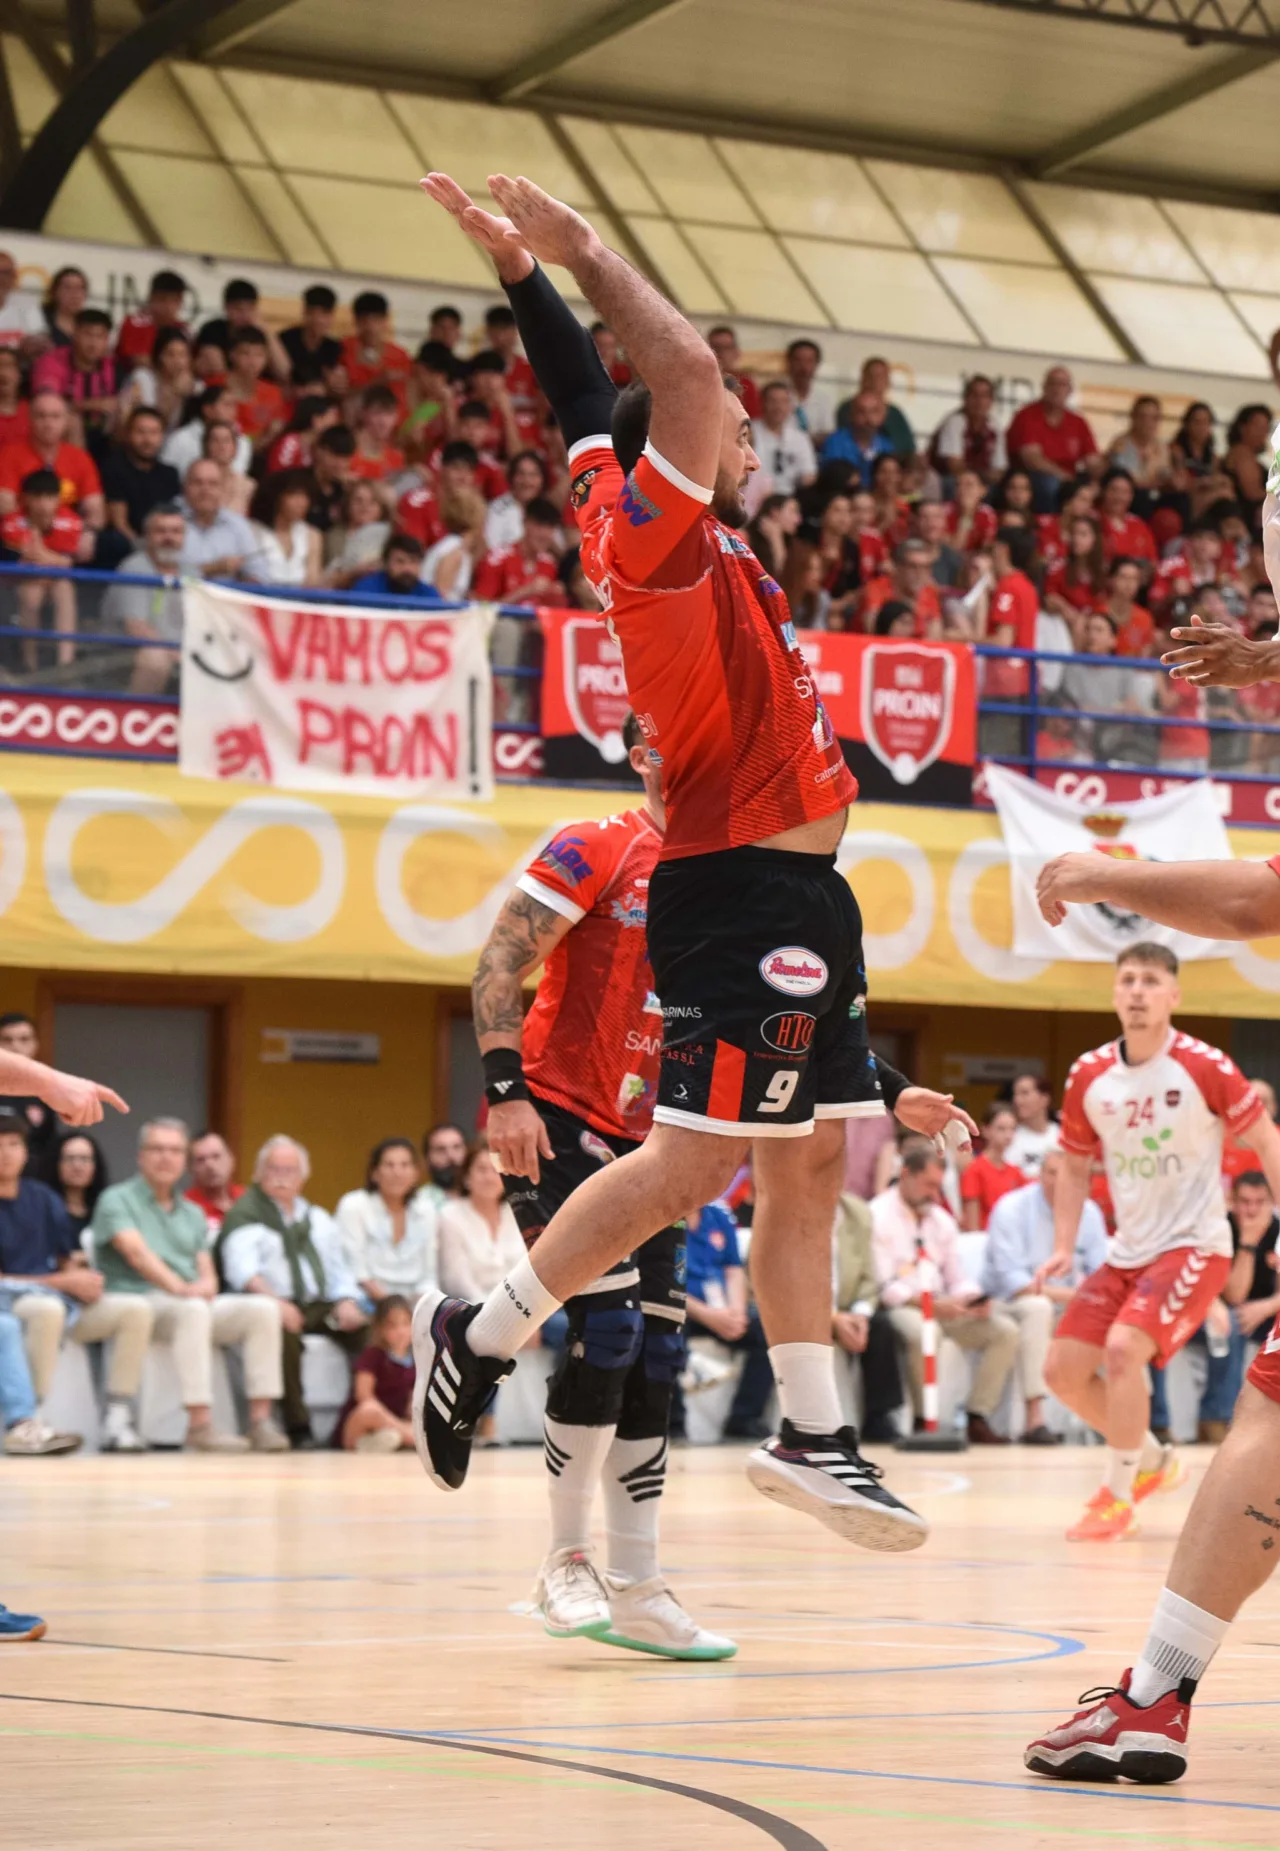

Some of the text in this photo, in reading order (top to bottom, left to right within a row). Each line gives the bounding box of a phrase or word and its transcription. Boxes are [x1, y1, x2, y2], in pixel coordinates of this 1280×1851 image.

[253, 605, 453, 685] VAMOS
[577, 664, 628, 695] PRO
[756, 1070, 799, 1112] 9
[1125, 1097, 1155, 1128] 24
[503, 1278, 532, 1319] ebok
